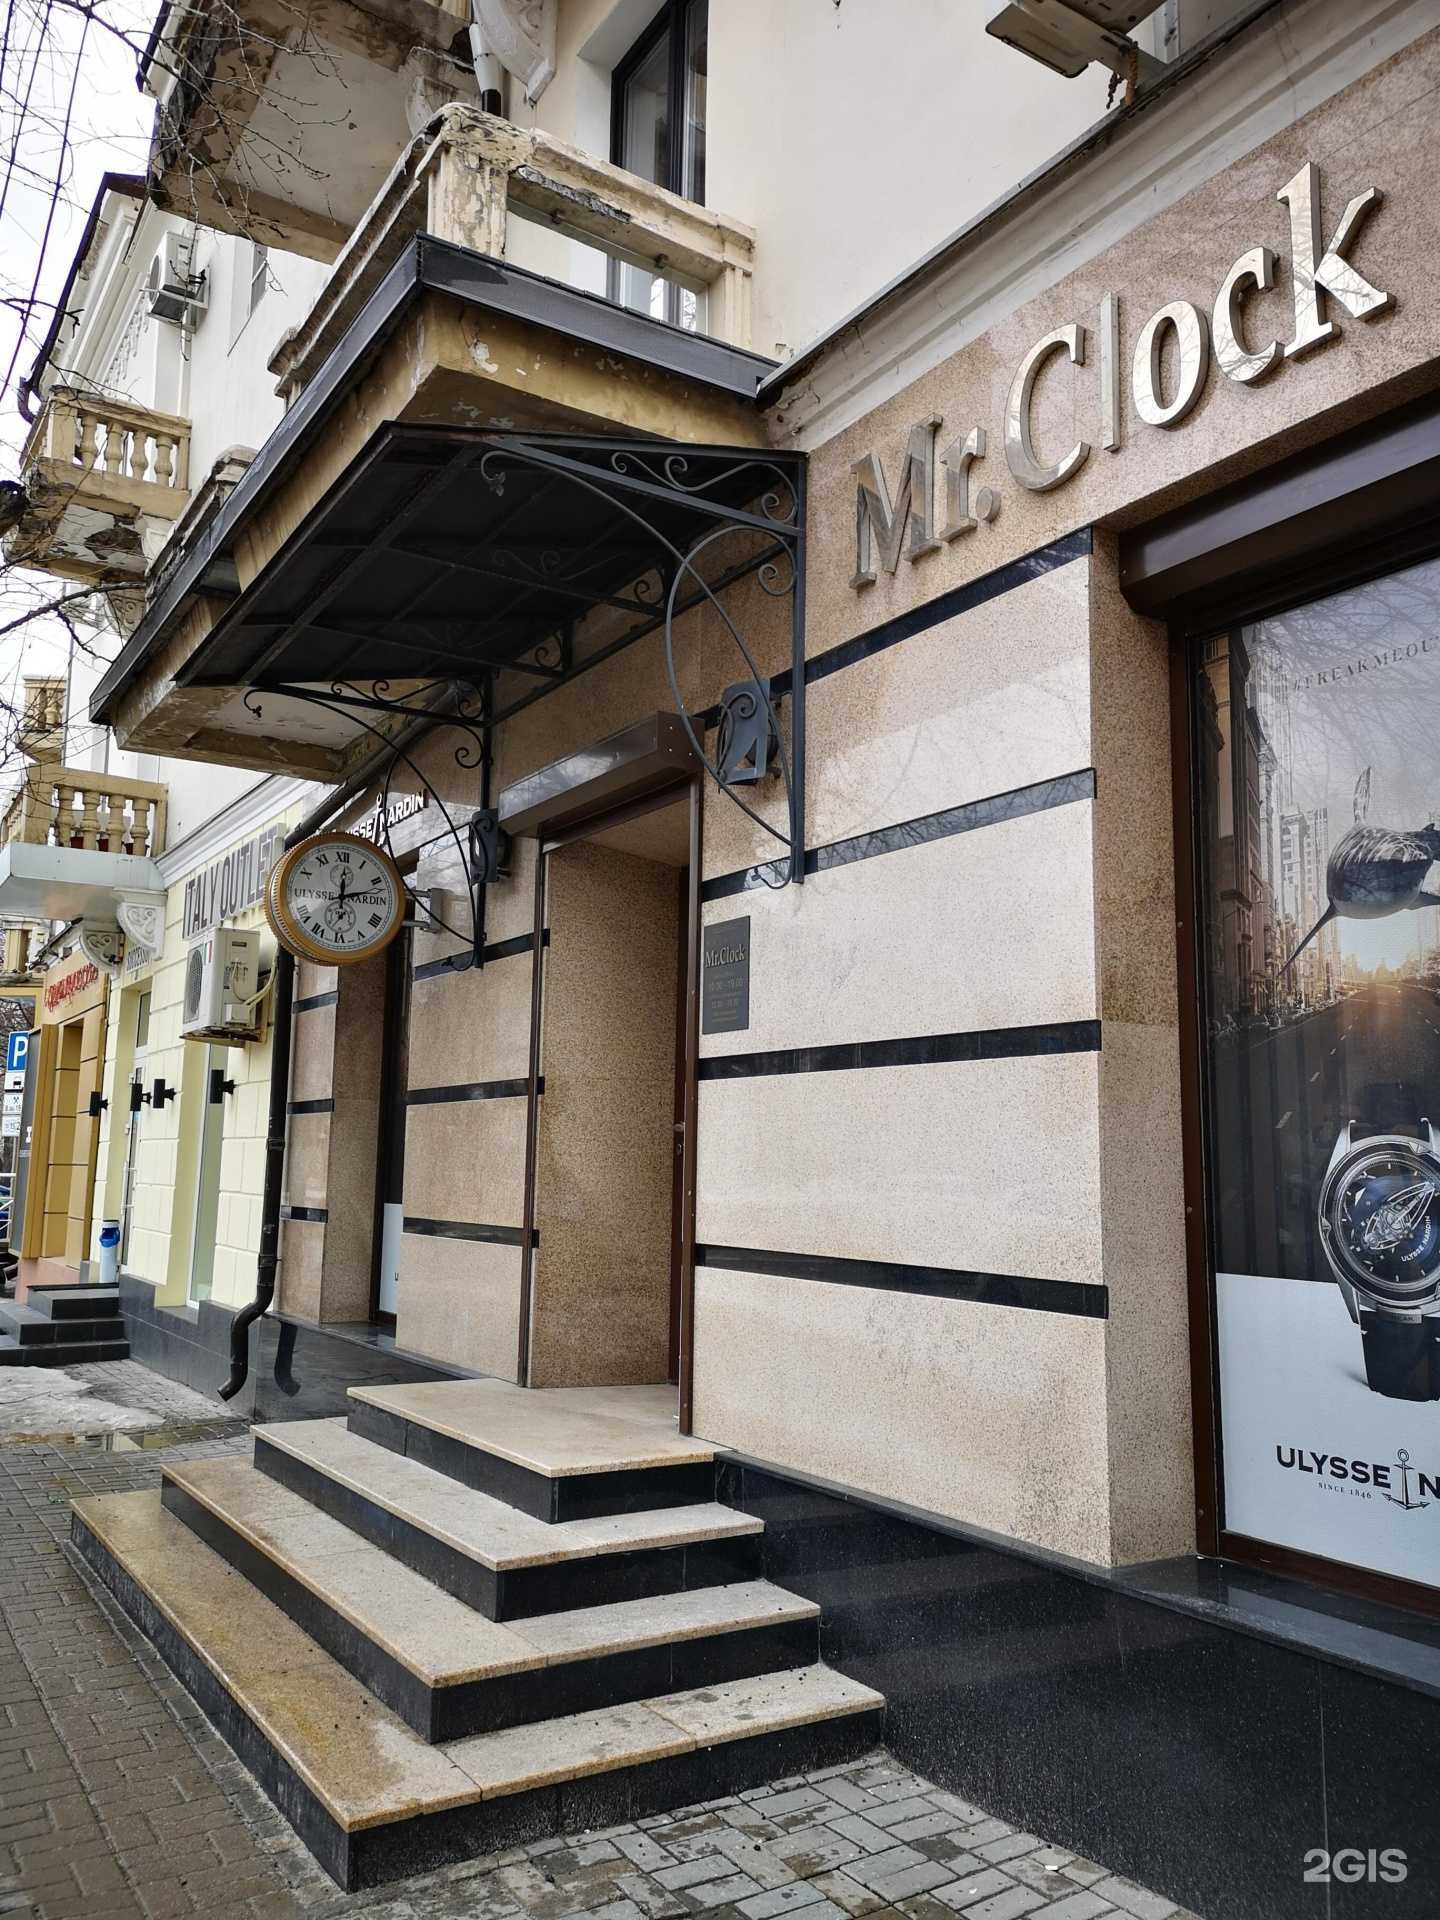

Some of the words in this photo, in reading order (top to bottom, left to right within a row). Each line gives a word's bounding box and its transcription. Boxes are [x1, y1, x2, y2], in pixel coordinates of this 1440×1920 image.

[13, 1036, 28, 1067] P
[1276, 1445, 1392, 1489] ULYSSE
[1318, 1482, 1345, 1494] SINCE
